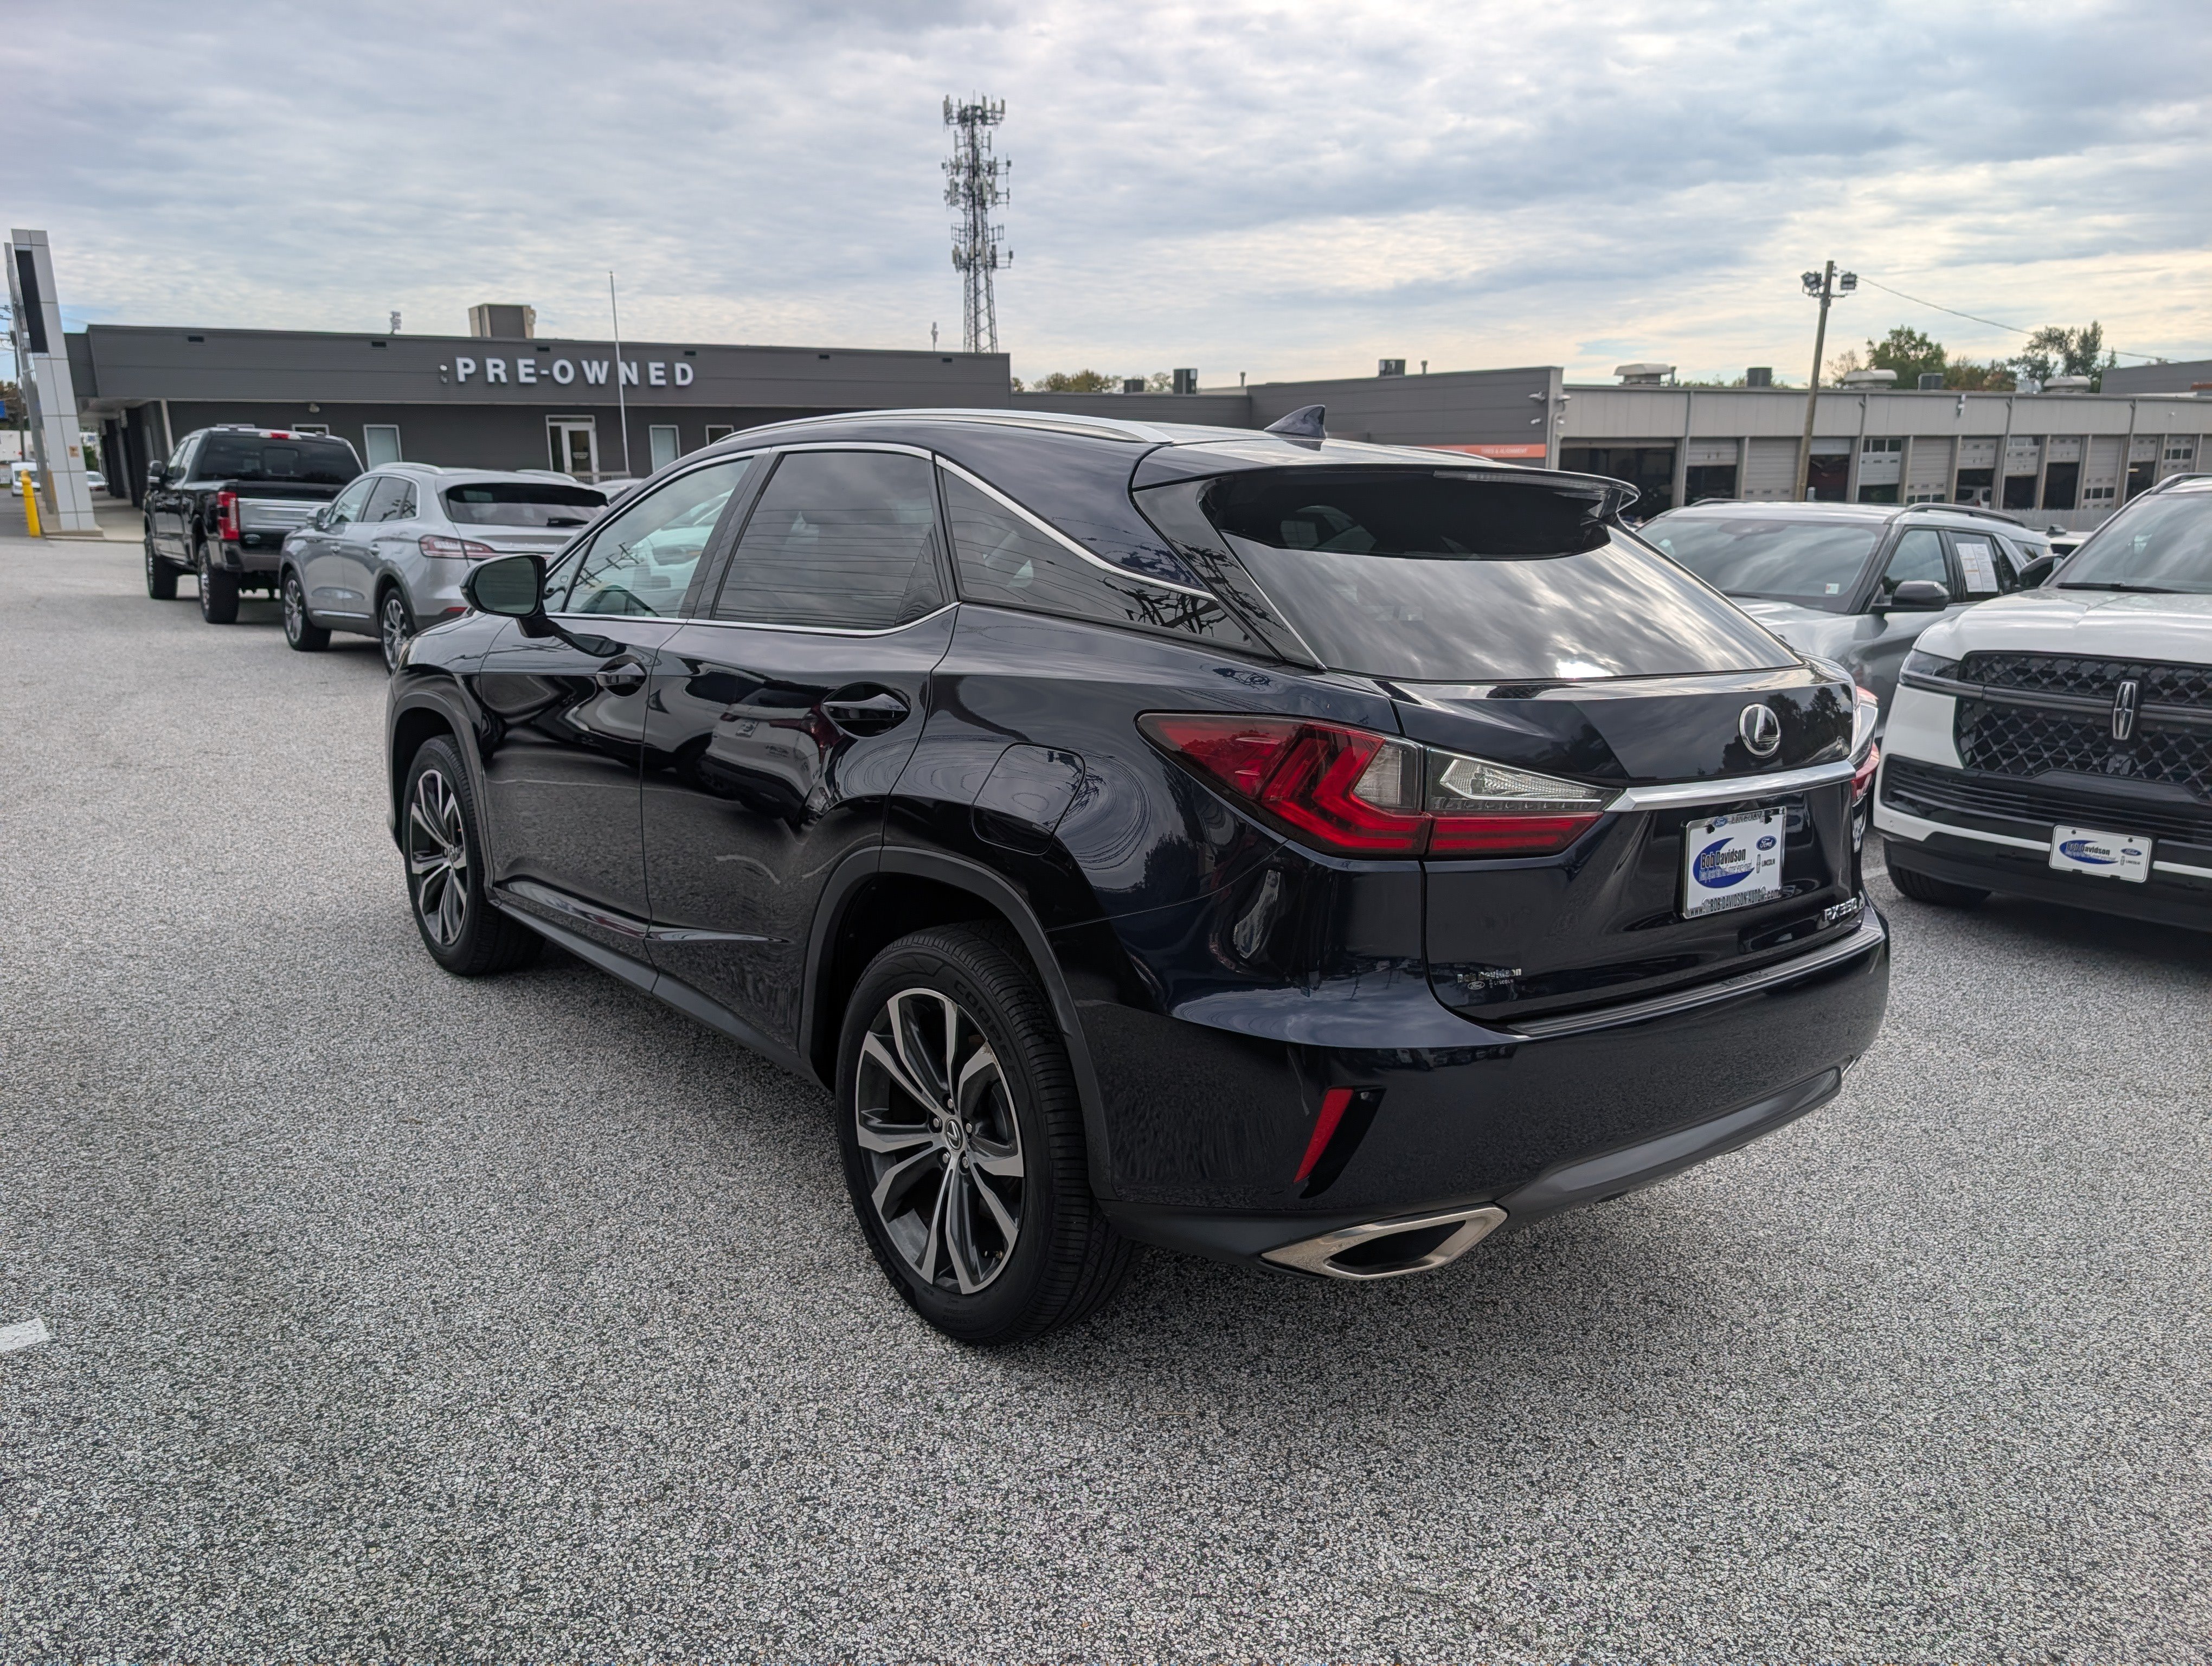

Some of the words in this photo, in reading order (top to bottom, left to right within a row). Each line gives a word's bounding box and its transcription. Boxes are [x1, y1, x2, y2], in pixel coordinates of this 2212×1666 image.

[455, 357, 693, 386] PRE-OWNED
[1701, 851, 1715, 869] Bob
[1715, 848, 1746, 866] Davidson
